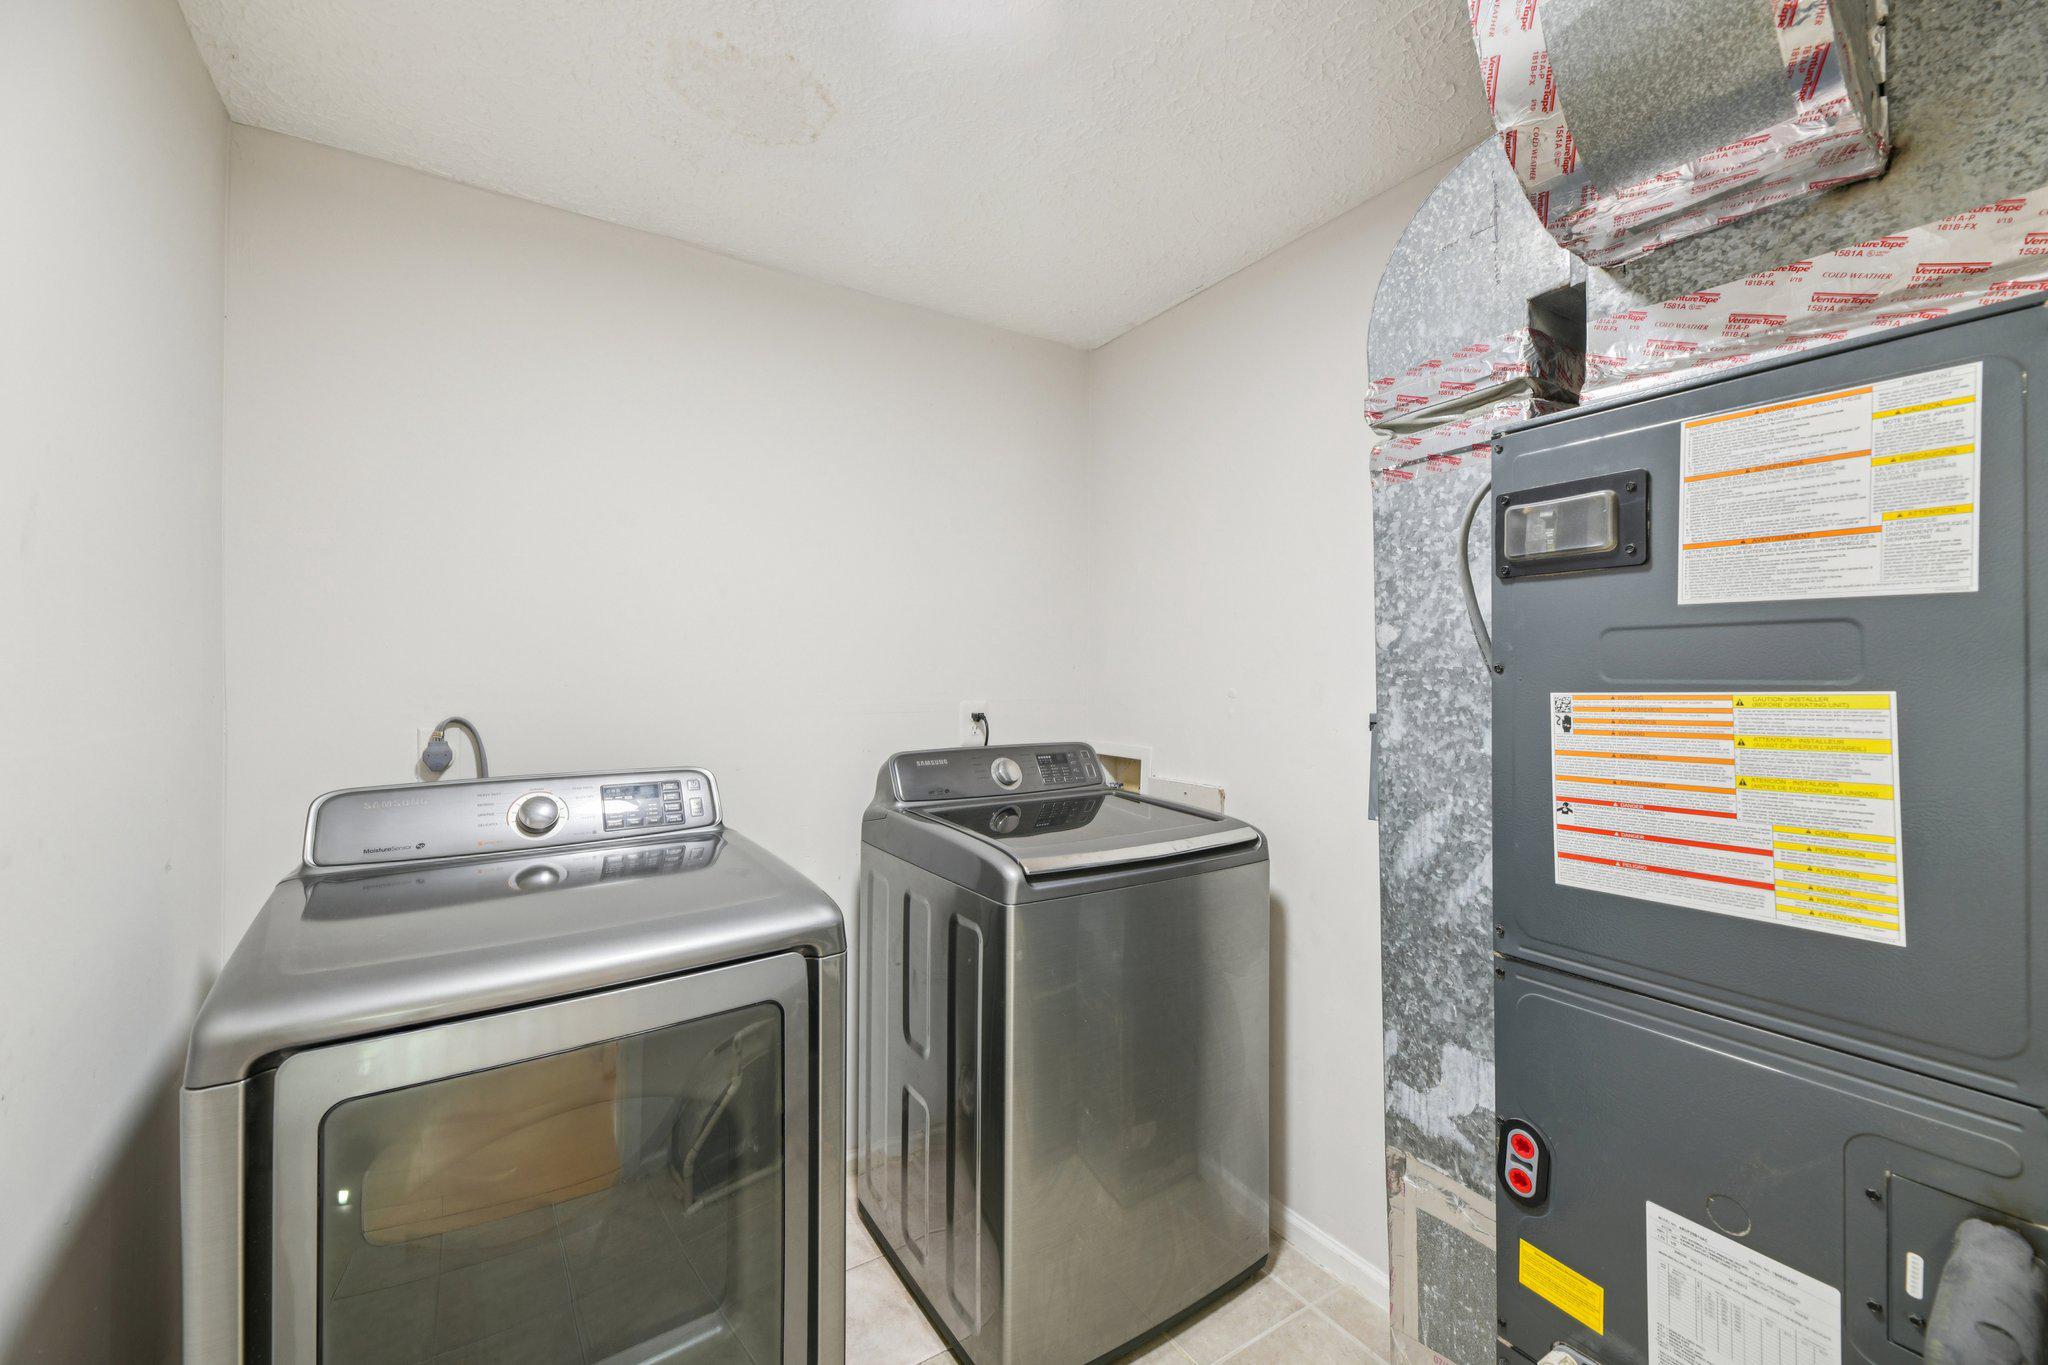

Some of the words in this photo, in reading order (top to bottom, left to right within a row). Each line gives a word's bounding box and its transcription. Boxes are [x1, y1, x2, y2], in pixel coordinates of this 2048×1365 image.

[1822, 271, 1848, 279] COLD
[1850, 272, 1894, 280] WEATHER
[1915, 266, 1992, 275] VentureTape
[1811, 295, 1879, 306] VentureTape
[1654, 321, 1675, 329] COLD
[1675, 322, 1709, 331] WEATHER
[1728, 316, 1788, 327] VentureTape
[1902, 370, 1952, 386] IMPORTANT
[1904, 401, 1942, 413] CAUTION
[1907, 506, 1956, 517] ATTENTION
[915, 758, 949, 767] SAMSUNG
[363, 799, 428, 810] SAMSUNG
[1814, 830, 1848, 839] CAUTION
[1815, 867, 1859, 878] ATTENTION
[1816, 886, 1851, 896] CAUTION
[1817, 911, 1862, 923] ATTENTION
